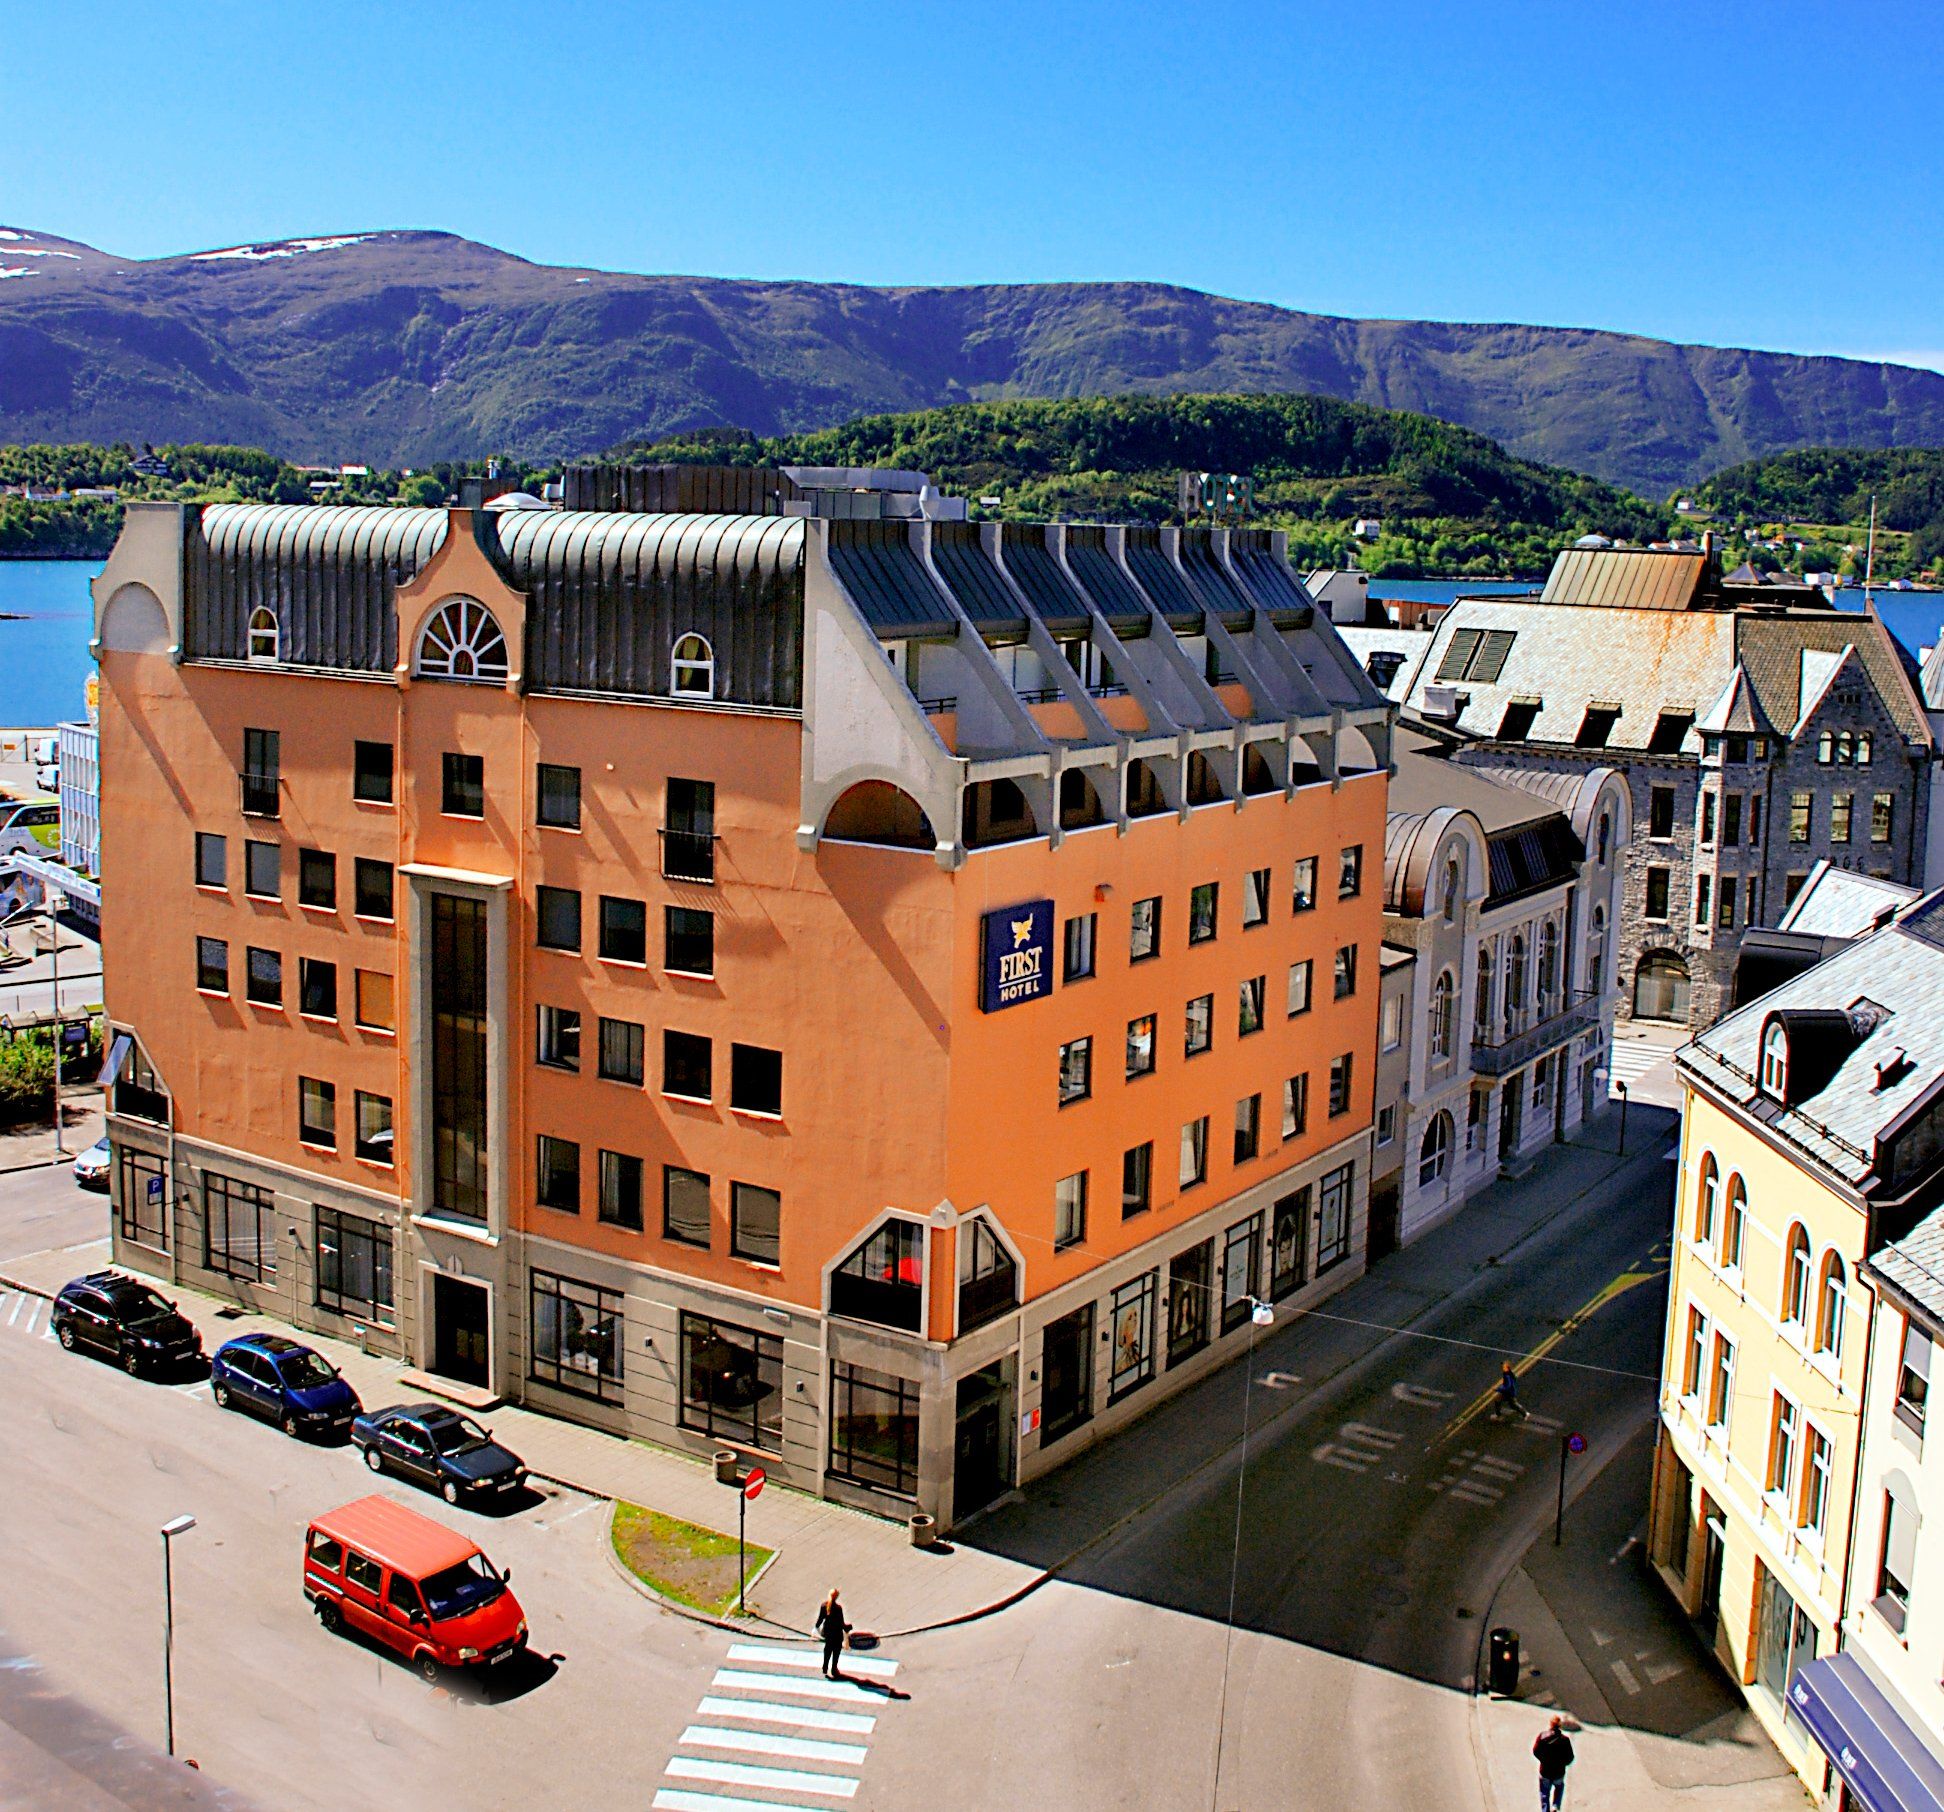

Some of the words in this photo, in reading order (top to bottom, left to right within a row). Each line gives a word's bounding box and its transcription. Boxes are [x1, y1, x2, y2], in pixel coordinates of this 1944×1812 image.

[1179, 472, 1255, 515] HOTEL
[999, 946, 1043, 983] FIRST
[1001, 980, 1040, 1002] HOTEL
[152, 1180, 159, 1192] P
